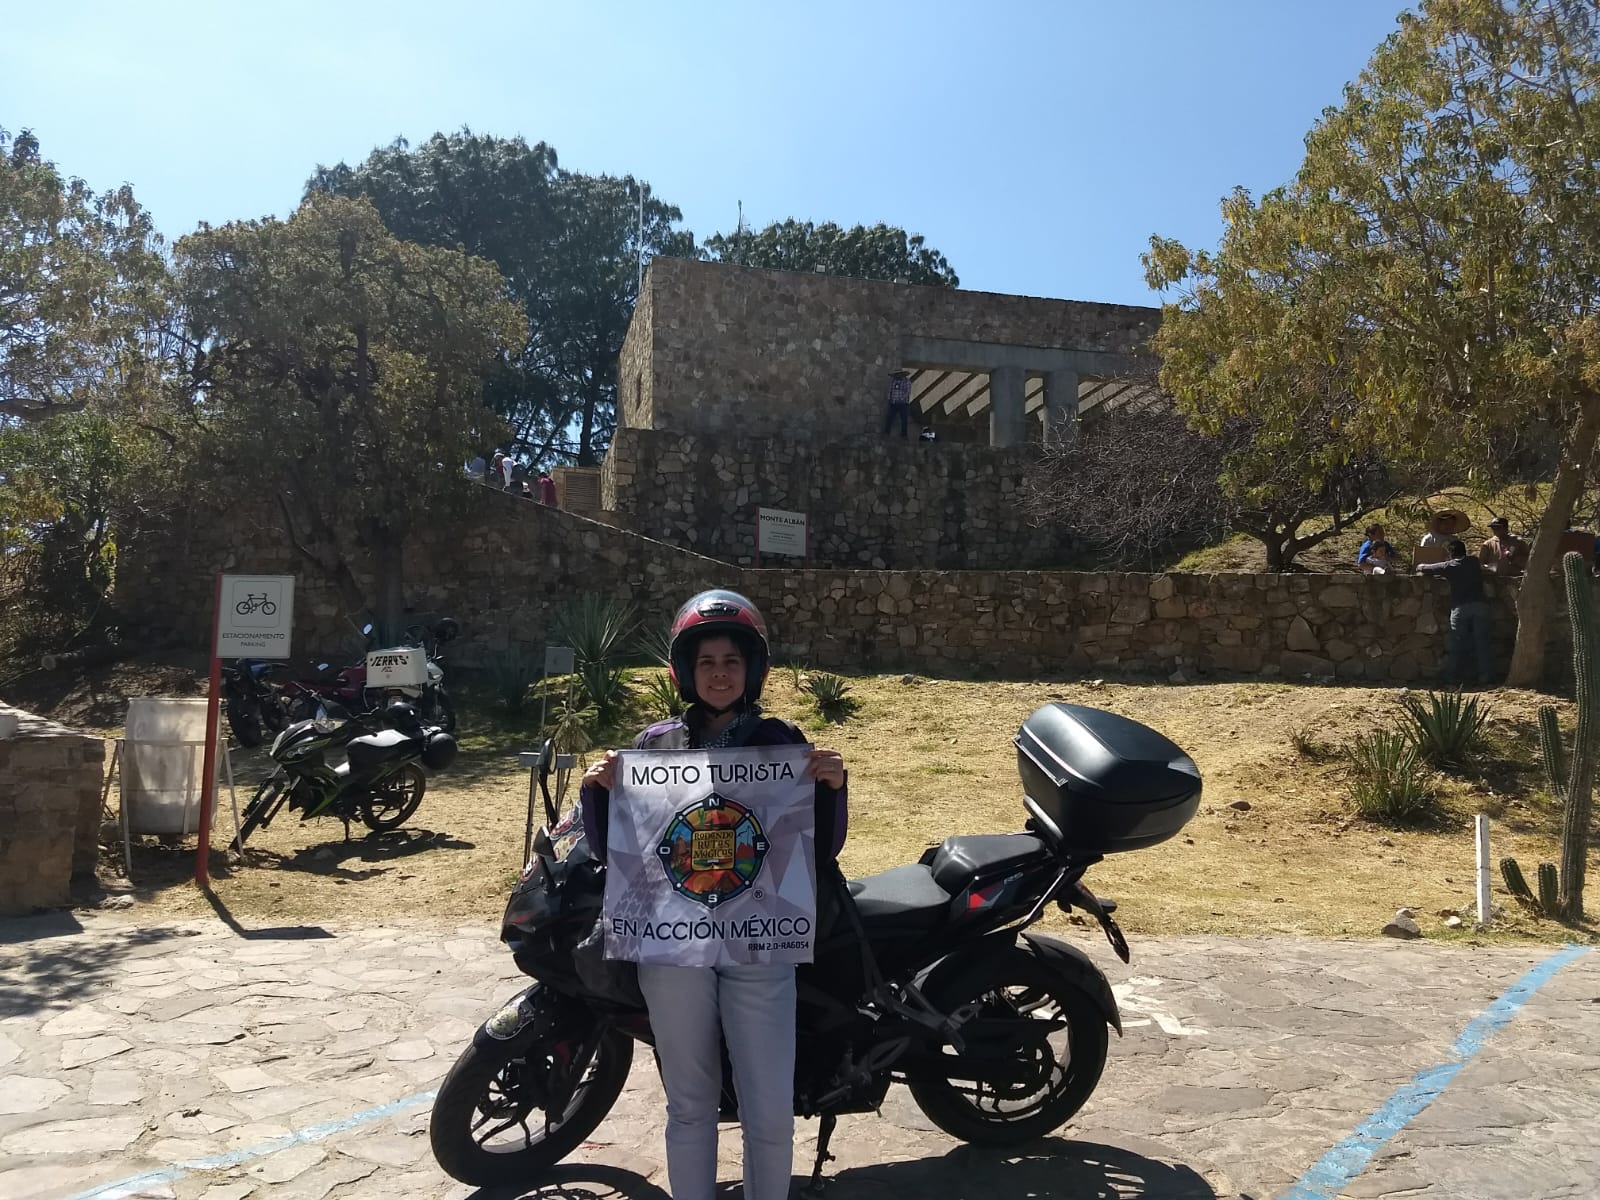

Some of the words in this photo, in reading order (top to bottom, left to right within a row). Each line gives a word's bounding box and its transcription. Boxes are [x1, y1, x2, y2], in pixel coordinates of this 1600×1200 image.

[760, 515, 783, 523] MONTE
[632, 766, 700, 785] MOTO
[707, 762, 794, 783] TURISTA
[708, 798, 720, 807] N
[756, 841, 766, 851] E
[707, 893, 718, 903] S
[612, 918, 637, 937] EN
[642, 916, 725, 941] ACCIÓN
[730, 914, 811, 939] MÉXICO
[748, 943, 765, 951] RRM
